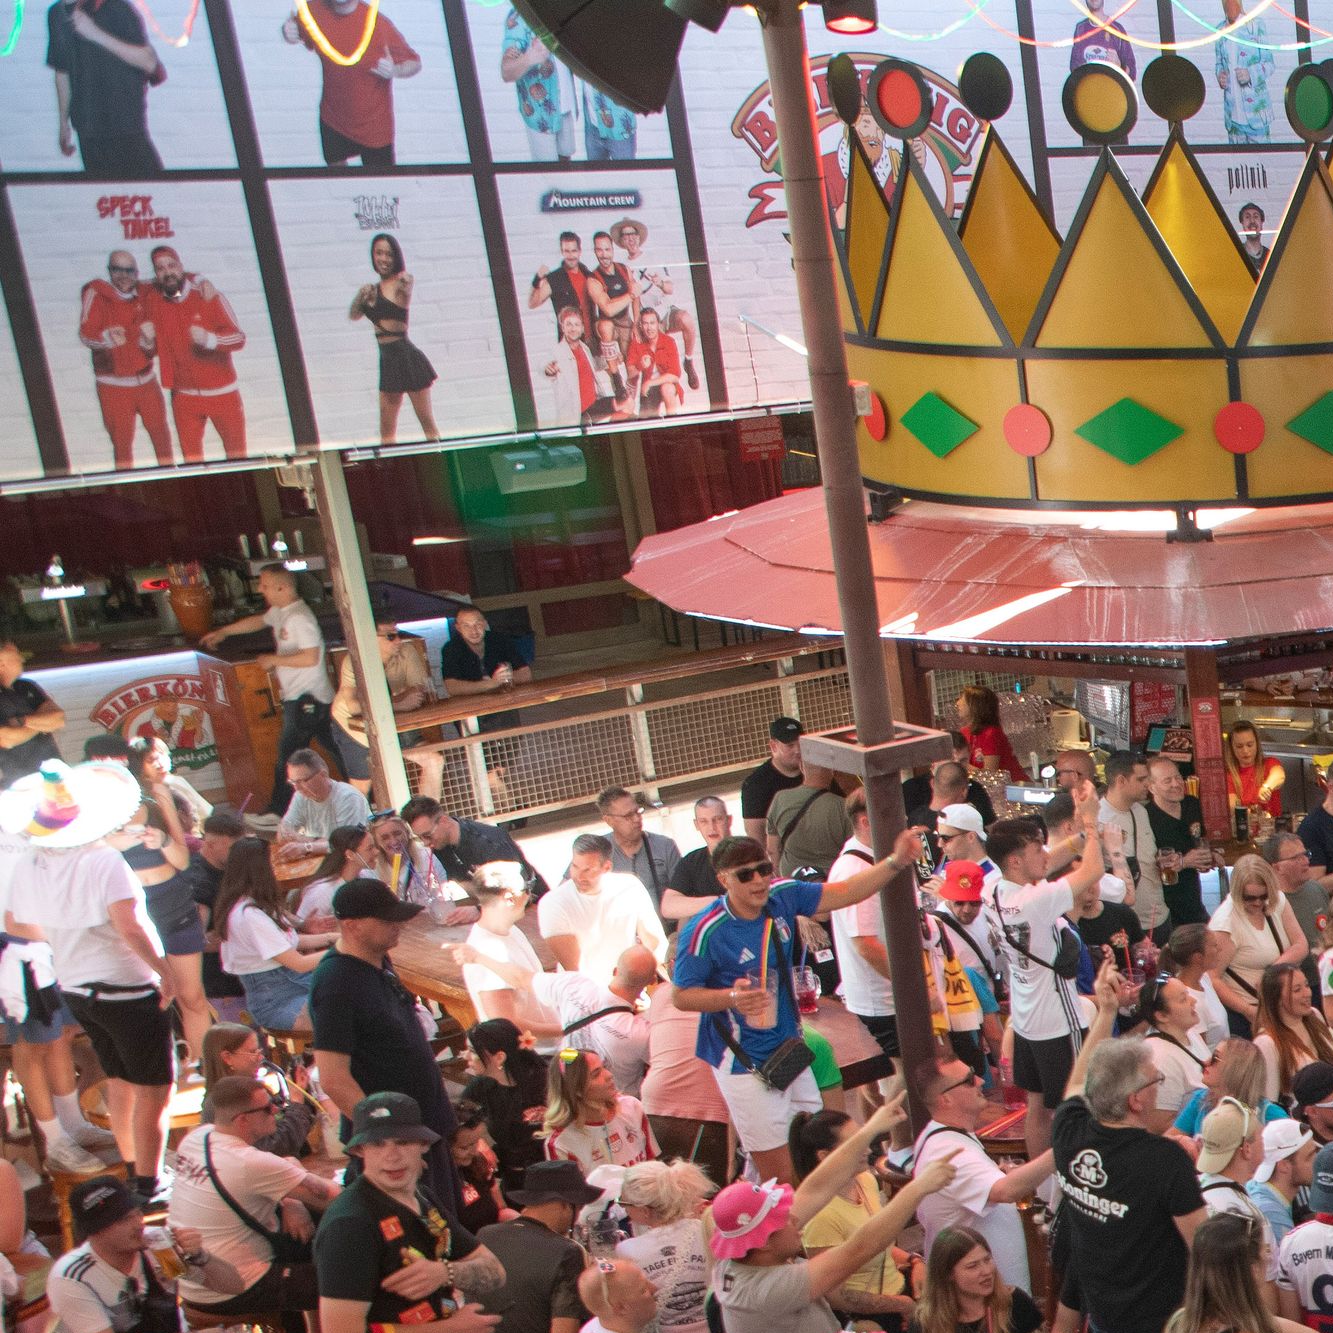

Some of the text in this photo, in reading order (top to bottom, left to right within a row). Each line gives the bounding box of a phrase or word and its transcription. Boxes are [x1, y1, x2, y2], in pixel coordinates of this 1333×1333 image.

[96, 195, 155, 219] SPECK
[550, 191, 636, 208] MOUNTAIN CREW
[99, 679, 207, 723] BIERKÖN
[1292, 1248, 1322, 1266] Bayern
